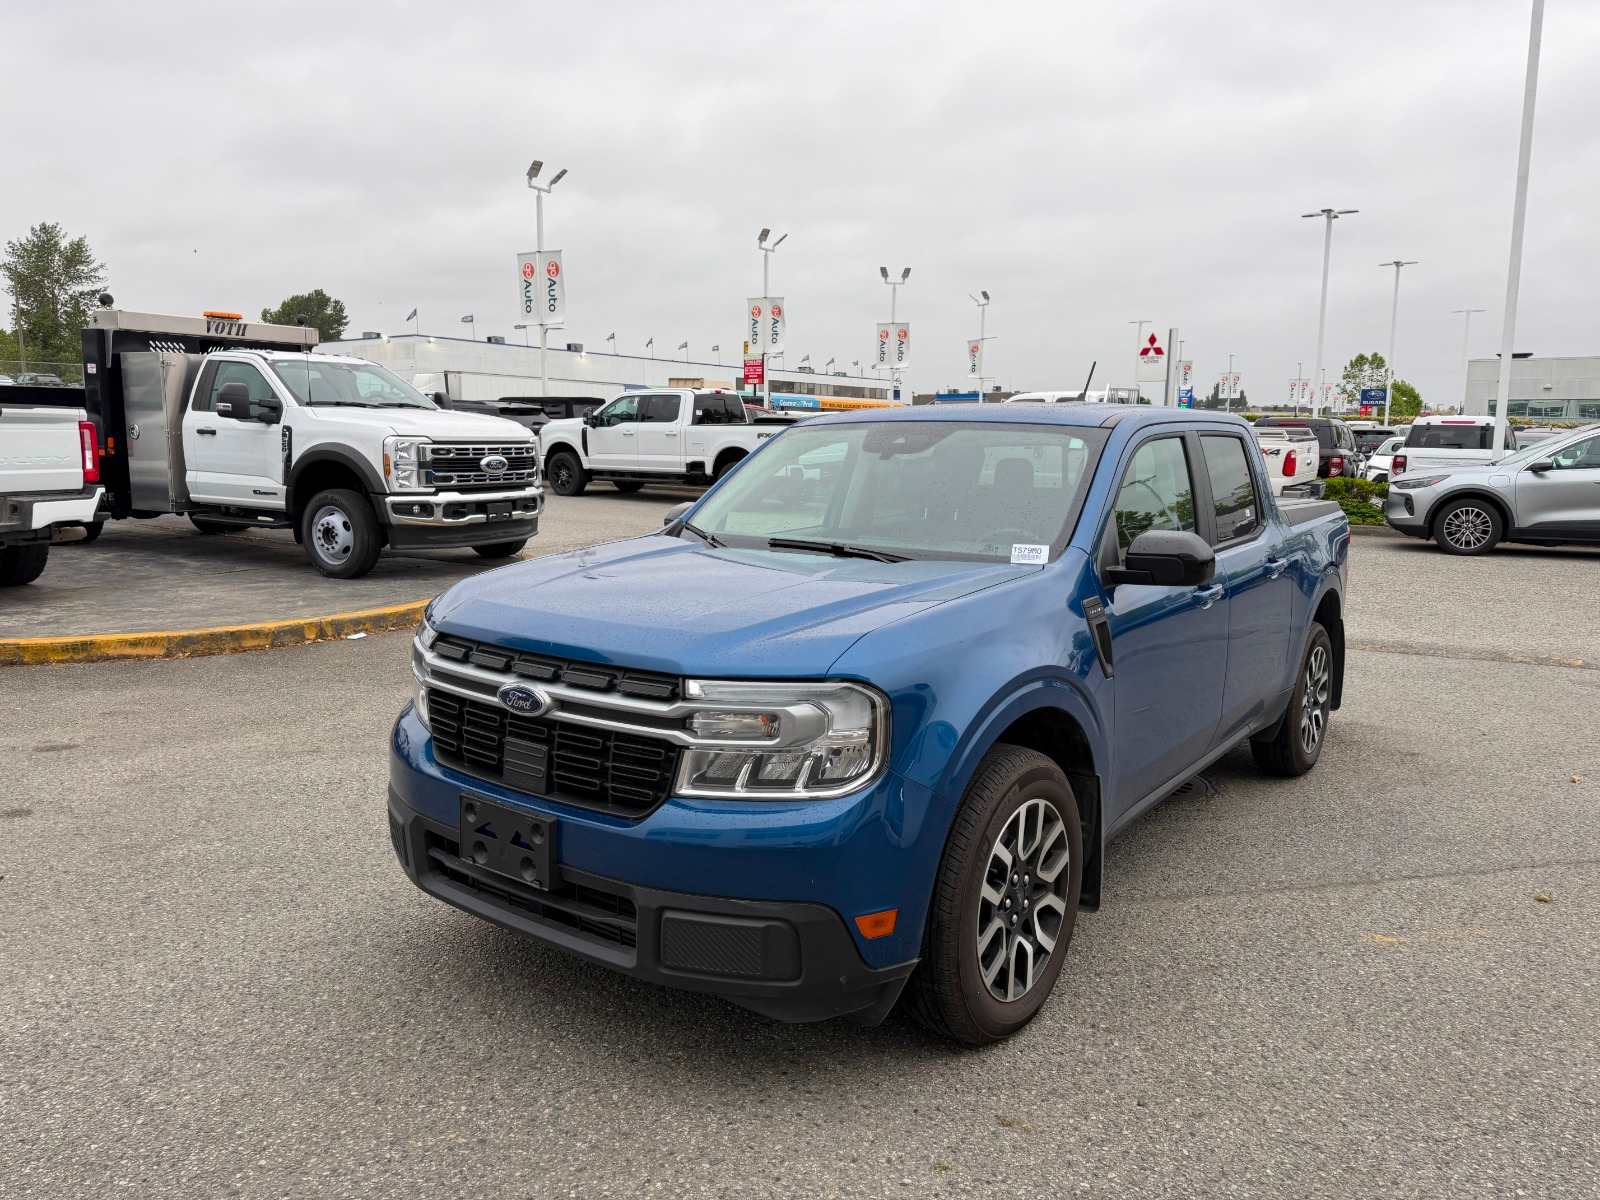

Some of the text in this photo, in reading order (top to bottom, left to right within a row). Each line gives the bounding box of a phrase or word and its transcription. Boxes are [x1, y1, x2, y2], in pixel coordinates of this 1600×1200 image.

[524, 279, 532, 313] Auto
[548, 278, 557, 312] Auto
[207, 319, 248, 336] VOTH
[771, 318, 779, 344] Auto
[506, 690, 532, 710] Ford
